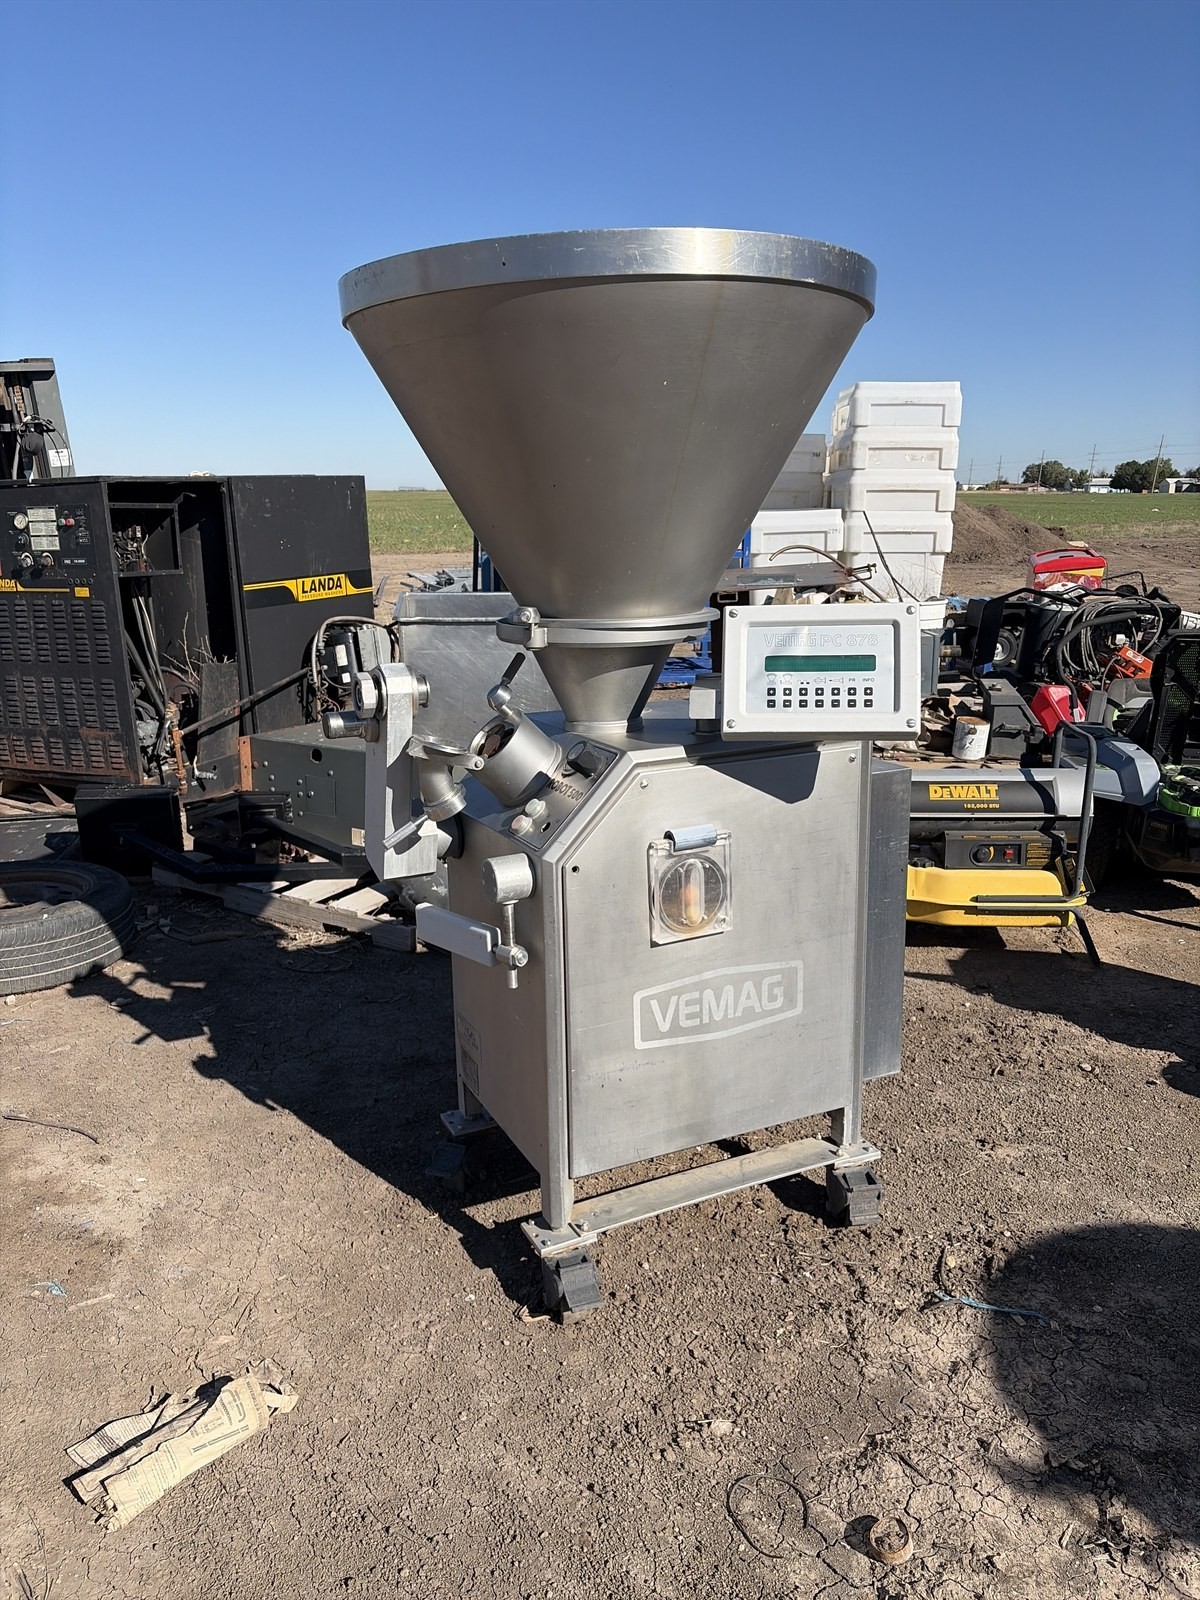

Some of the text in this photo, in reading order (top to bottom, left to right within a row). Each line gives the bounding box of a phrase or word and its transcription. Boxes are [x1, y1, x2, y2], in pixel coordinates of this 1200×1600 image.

[302, 576, 342, 594] LANDA
[301, 592, 323, 600] PRESSURE
[764, 632, 879, 648] VEMAG PC 878
[546, 778, 584, 801] ROBOT 500
[650, 974, 784, 1033] VEMAG
